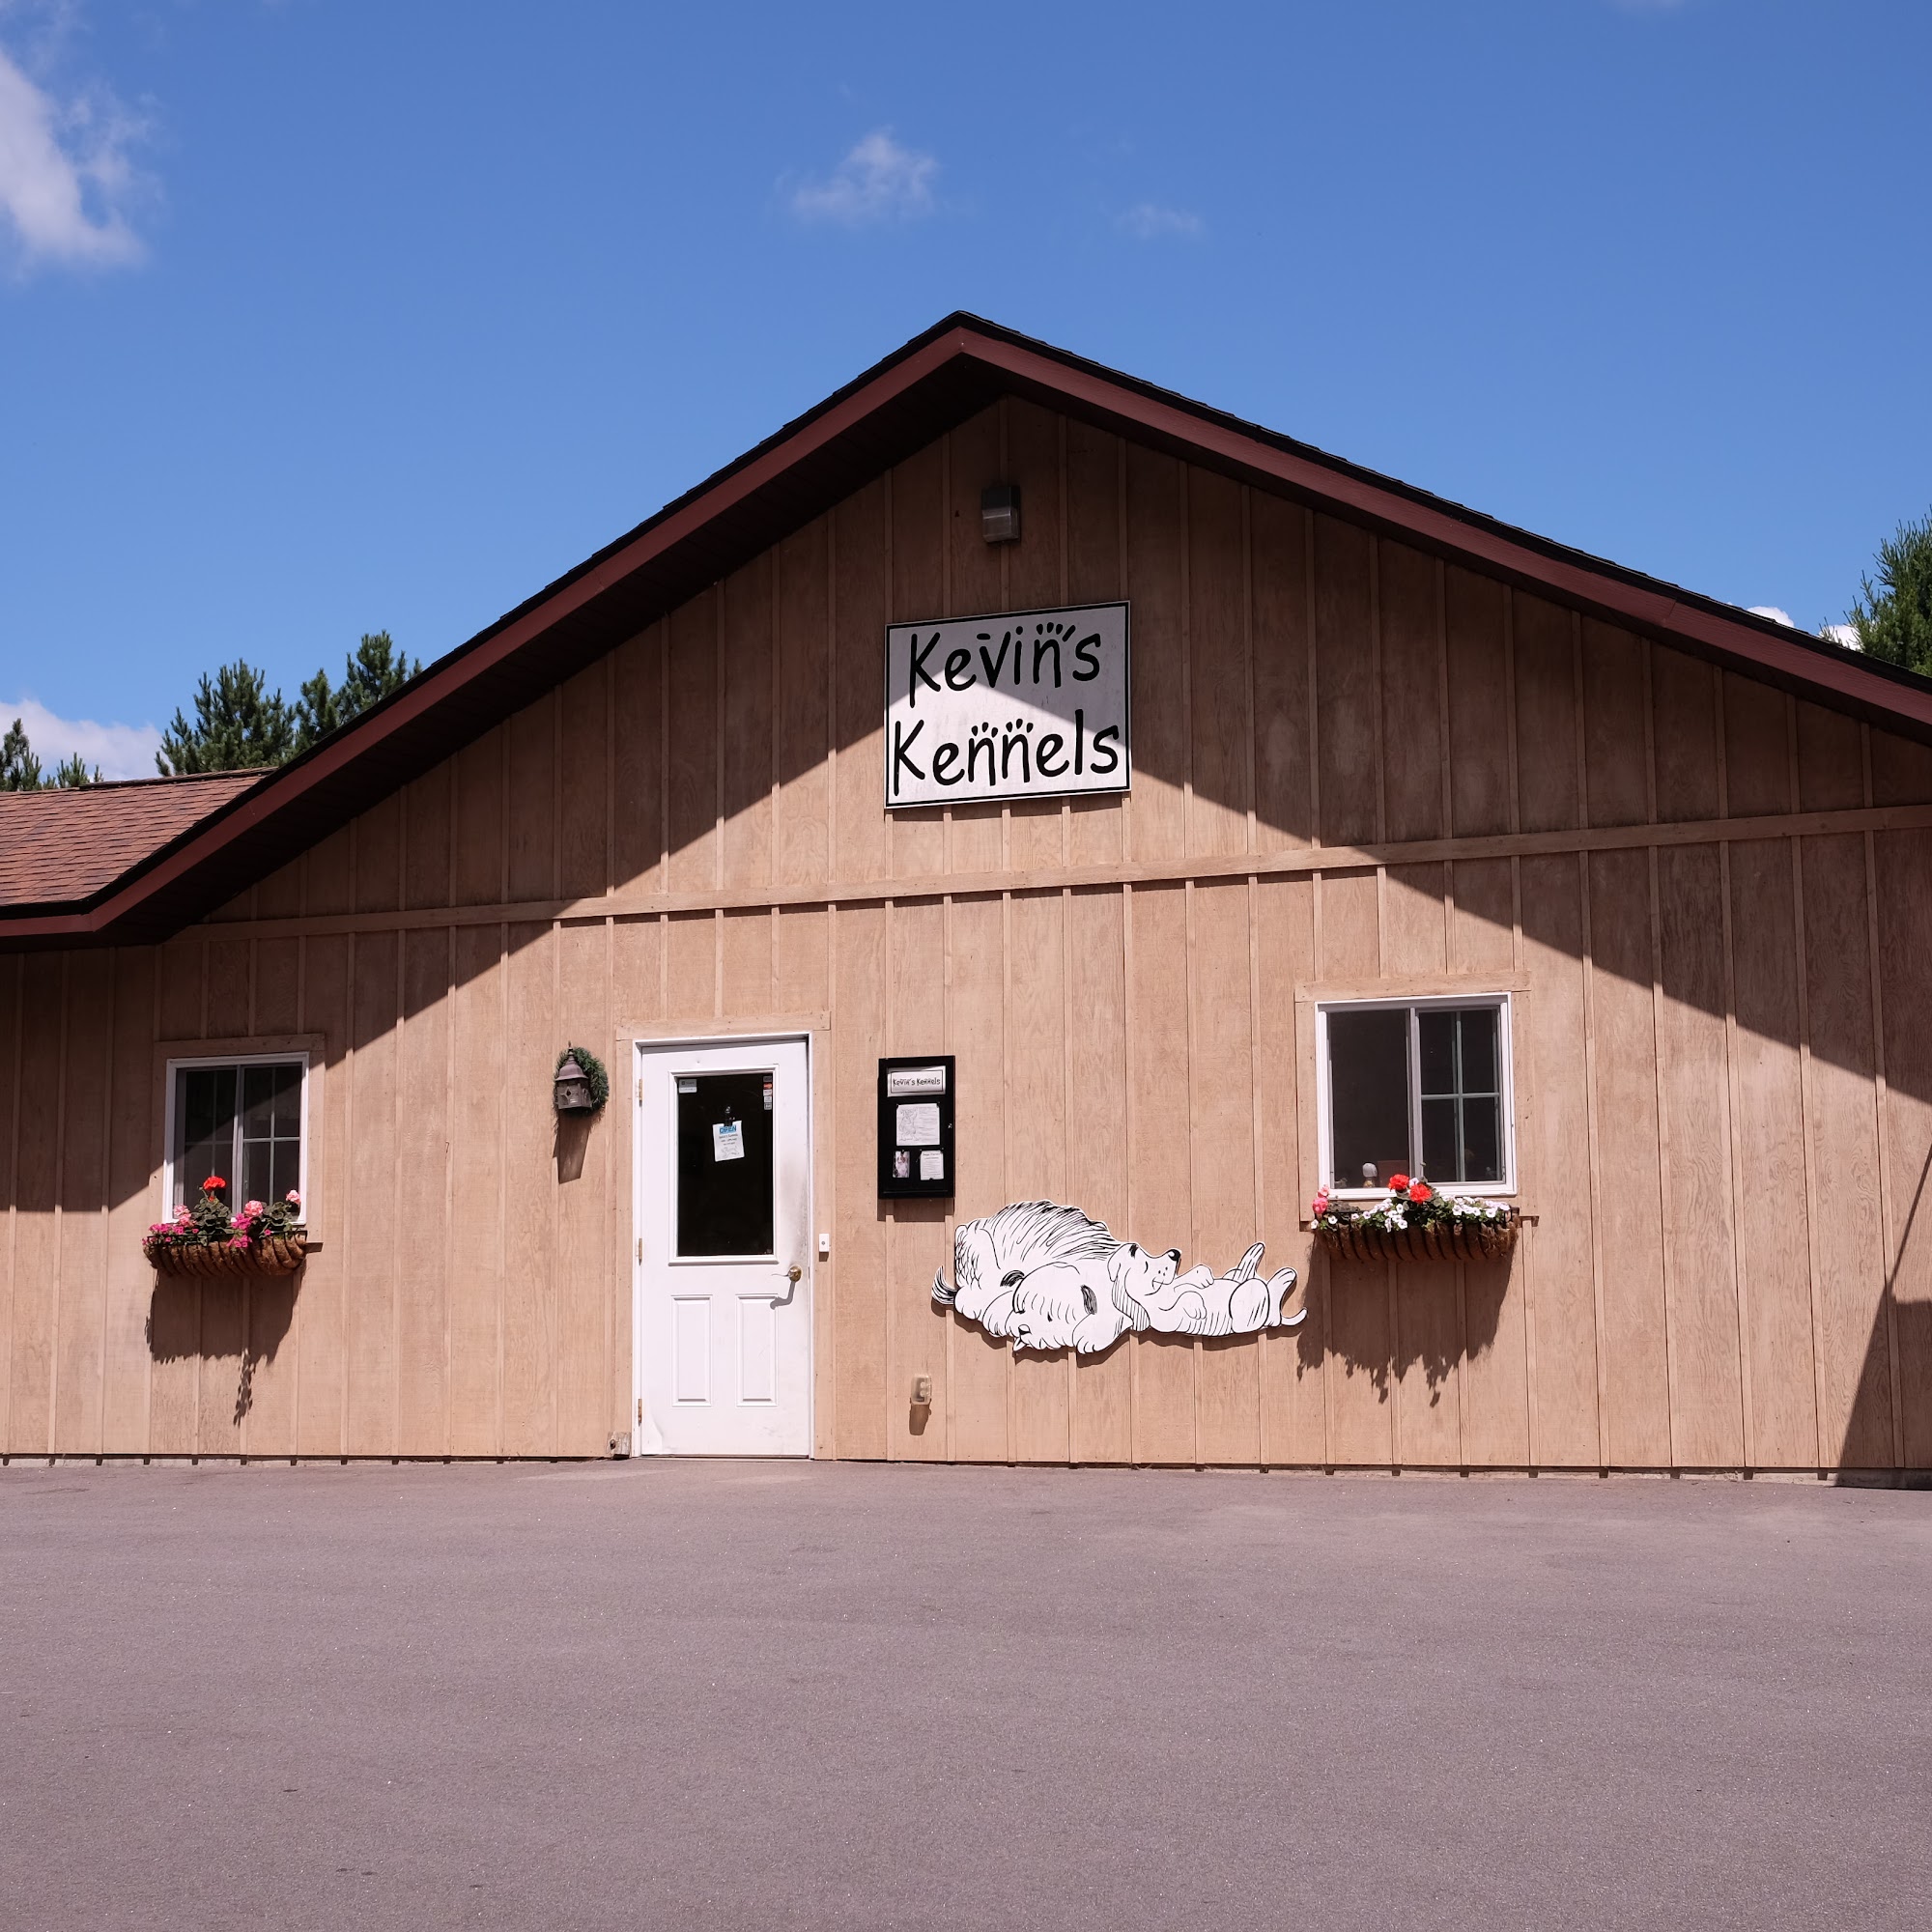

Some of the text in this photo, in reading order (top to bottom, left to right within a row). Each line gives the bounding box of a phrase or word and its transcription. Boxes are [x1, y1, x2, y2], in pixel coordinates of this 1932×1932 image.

[894, 709, 1120, 796] Kennels
[917, 1077, 941, 1087] Kennels
[720, 1125, 737, 1134] OPEN
